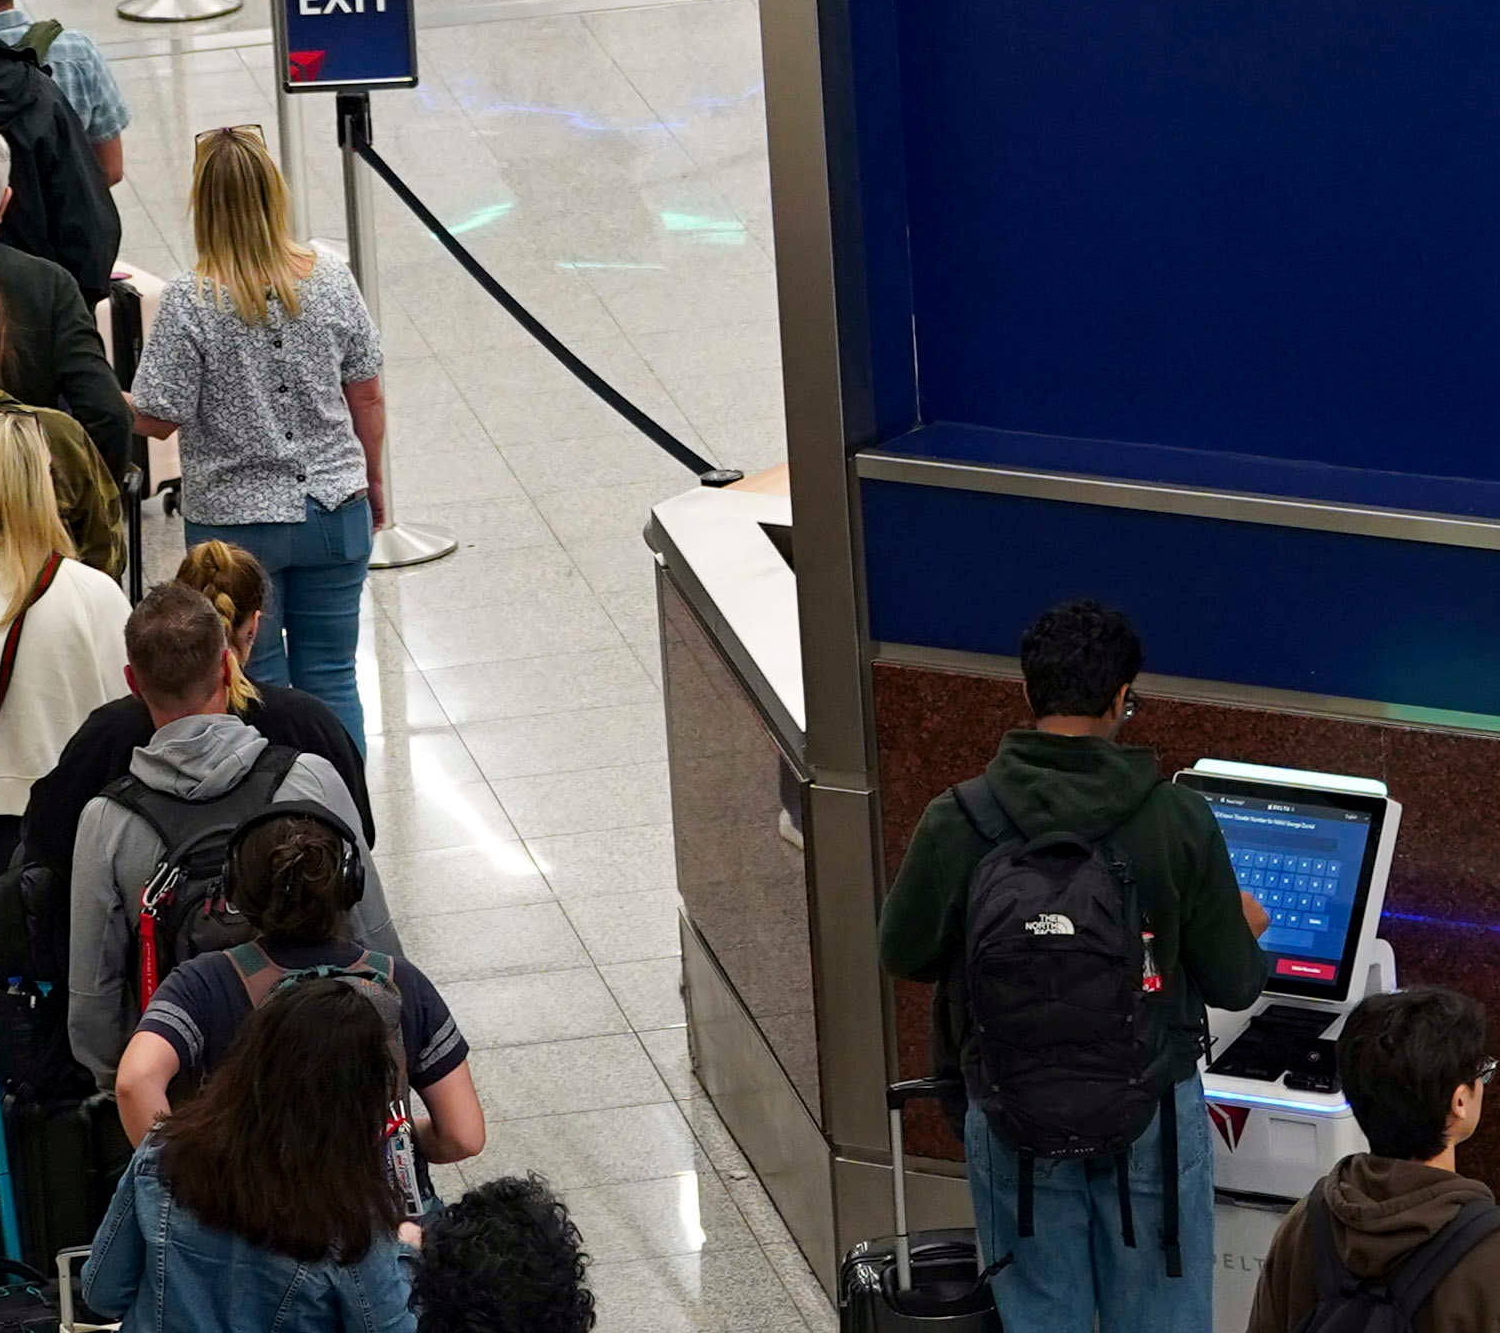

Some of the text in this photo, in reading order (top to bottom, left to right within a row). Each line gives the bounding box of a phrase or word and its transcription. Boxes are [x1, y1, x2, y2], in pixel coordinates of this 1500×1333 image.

[1037, 913, 1059, 922] THE
[1025, 921, 1059, 930] NORTH
[1222, 1253, 1267, 1273] ELT
